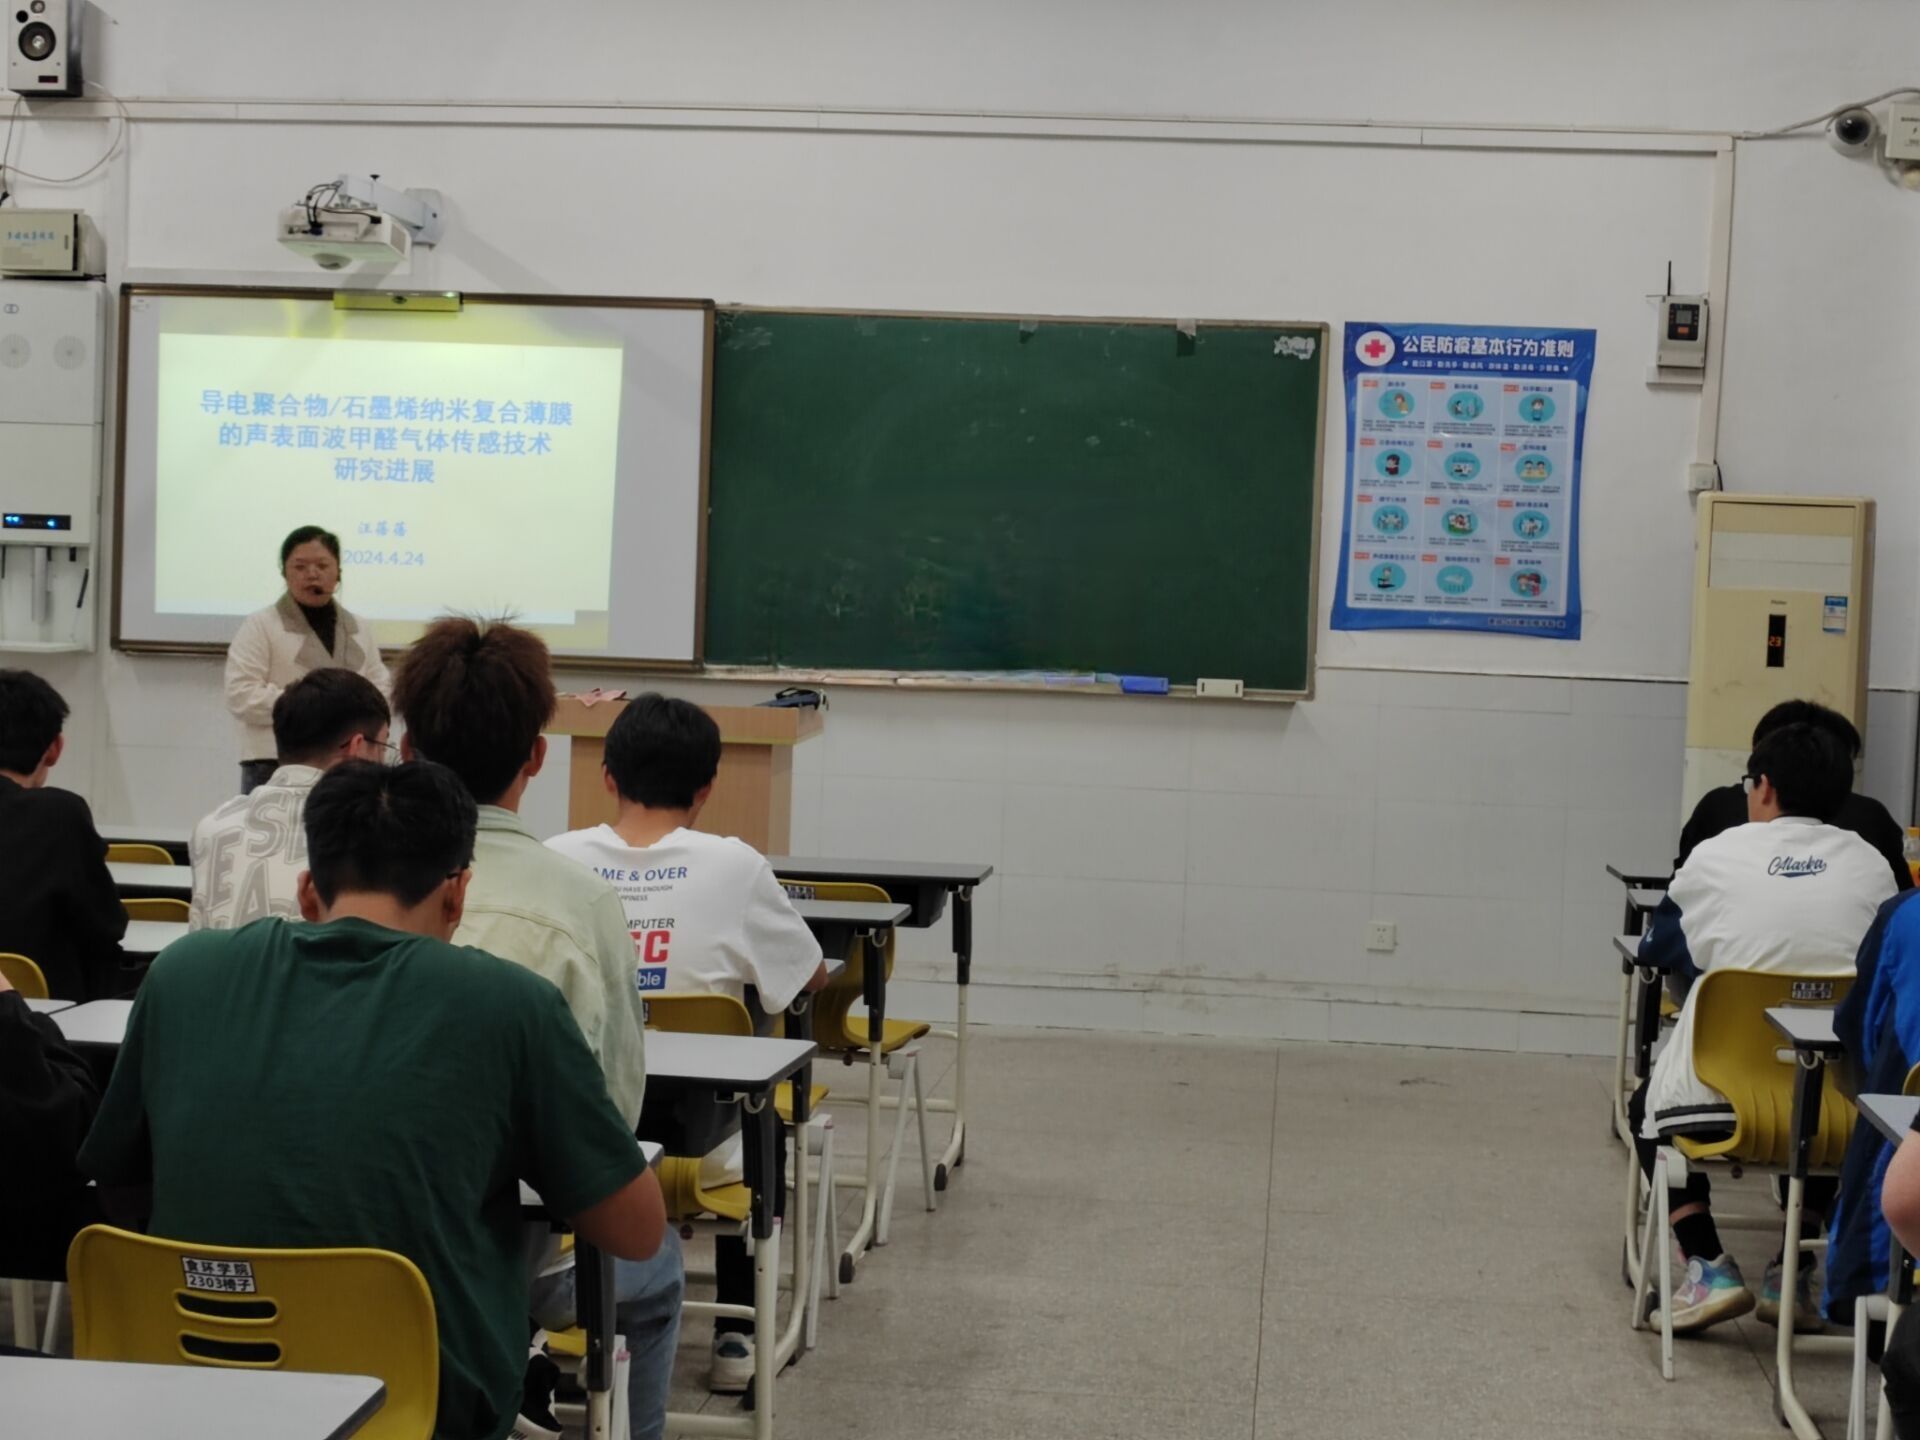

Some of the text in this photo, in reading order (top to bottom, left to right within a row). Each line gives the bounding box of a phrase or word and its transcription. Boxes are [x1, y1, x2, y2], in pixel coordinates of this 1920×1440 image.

[1402, 335, 1575, 358] 公民防疫基本行为准则
[200, 389, 573, 426] 导电聚合物/石墨烯纳米复合薄膜
[219, 422, 552, 455] 的声表面波甲醛气体传感技术
[334, 457, 436, 484] 研究进展
[343, 550, 425, 565] 2024.4.24
[629, 869, 640, 881] &
[644, 866, 688, 881] OVER
